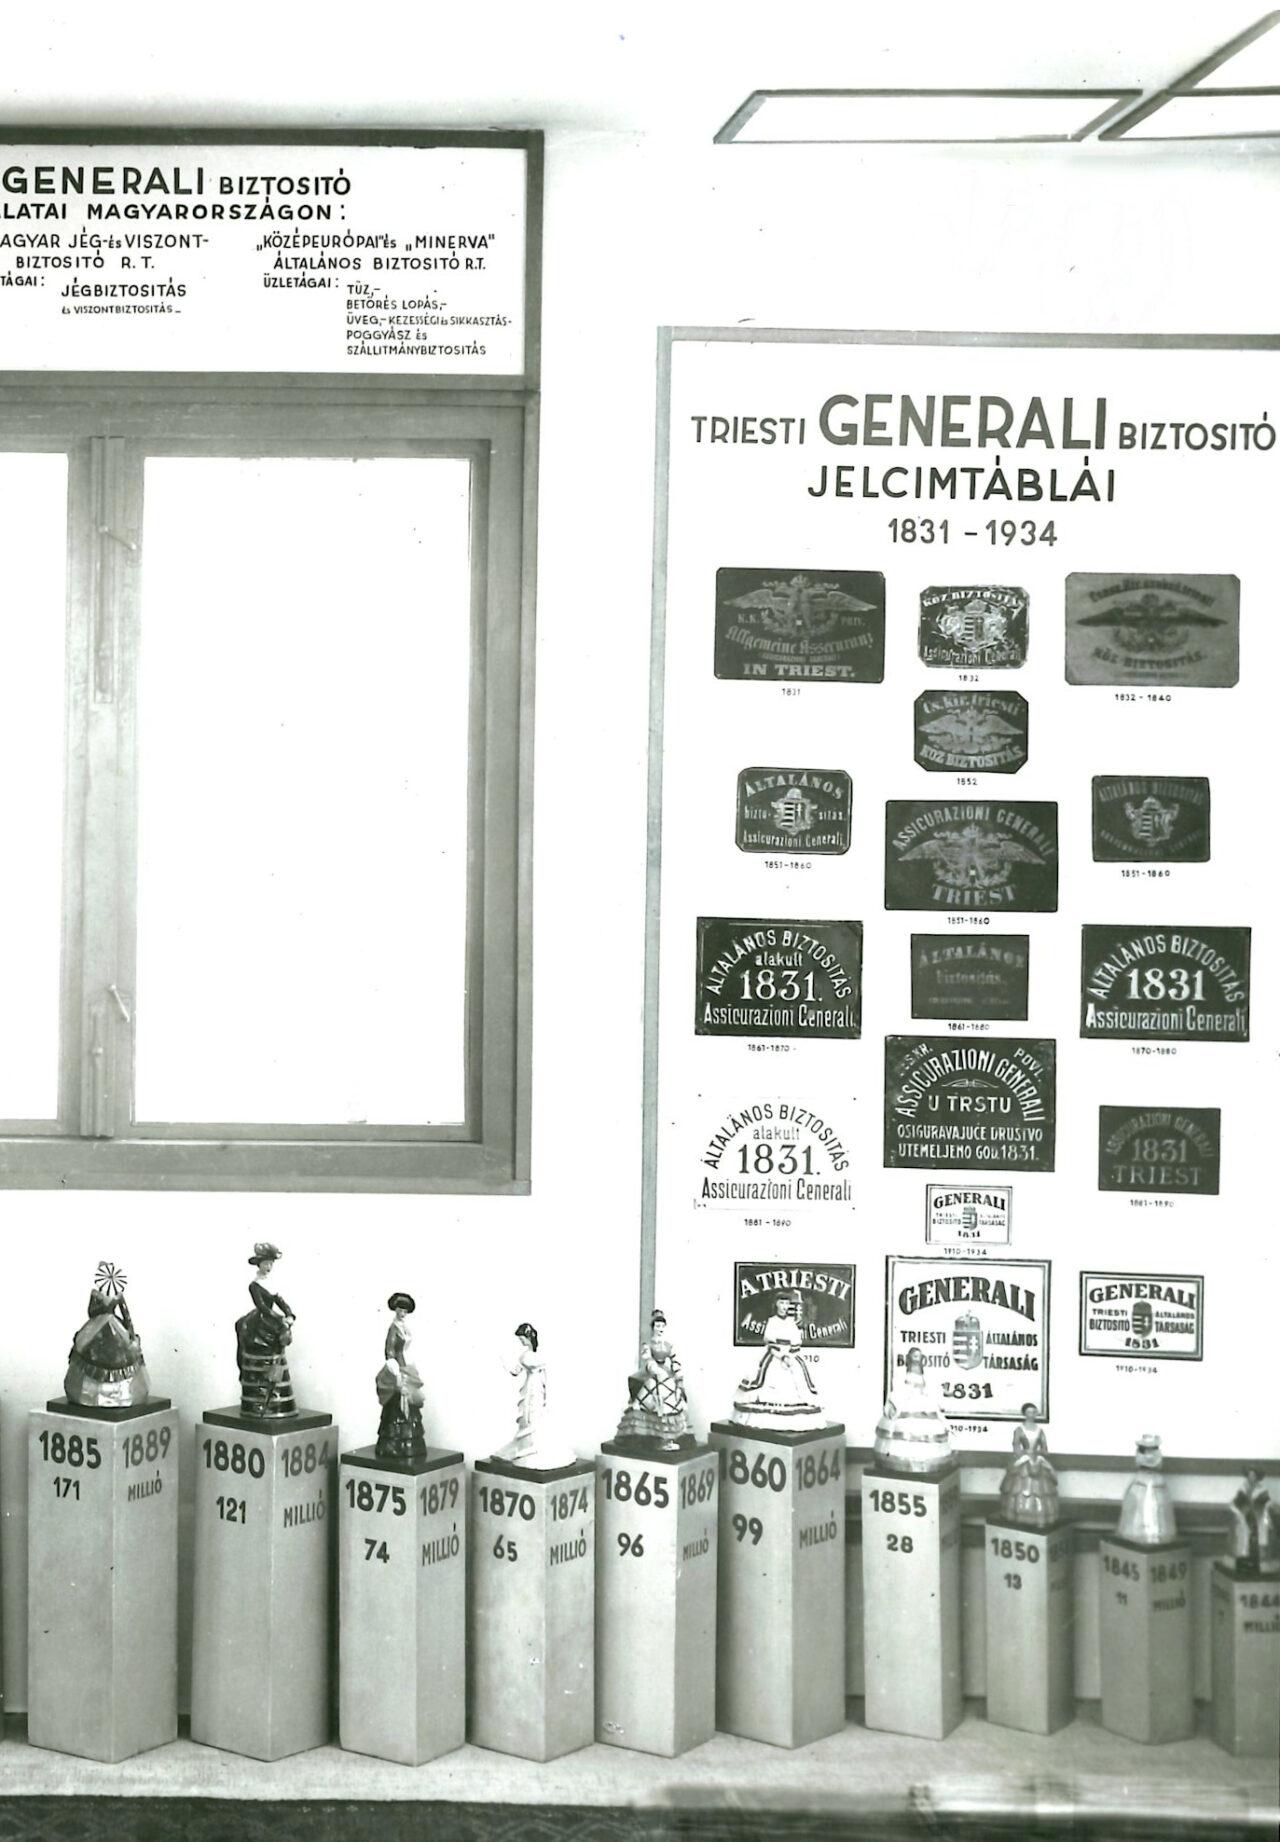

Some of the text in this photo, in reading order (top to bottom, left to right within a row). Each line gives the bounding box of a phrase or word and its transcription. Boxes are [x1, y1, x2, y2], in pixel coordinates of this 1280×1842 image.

[2, 166, 203, 194] GENERALI
[219, 168, 351, 195] BIZTOSITÓ
[16, 249, 104, 268] BIZTOSITÓ
[273, 251, 486, 269] ÁLTALÁNOS BIZTOSITÓ R.T.
[62, 277, 186, 297] JÉGBIZTOSITÁS
[347, 326, 411, 340] POGGYÁSZ
[691, 394, 1276, 450] TRIESTI GENERALI BIZTOSITÓ
[808, 456, 1115, 501] JELCIMTÁBLÁI
[888, 517, 950, 544] 1831
[743, 663, 767, 676] IN
[892, 805, 990, 850] ASSICURAZIONI
[996, 809, 1055, 856] GENERALI
[932, 884, 1017, 906] TRIEST
[755, 951, 803, 966] alakult
[1128, 968, 1206, 1000] 1831
[704, 1002, 794, 1026] Assicurazioni
[1086, 1003, 1183, 1030] Assicurazioni
[895, 1049, 1045, 1121] ASSICURAZIONI GENERALI
[928, 1095, 1011, 1113] U TRSTU
[898, 1143, 971, 1159] UTEMELJENO
[1132, 1138, 1187, 1163] 1831
[702, 1177, 852, 1201] Assicurazioni Generali
[1113, 1165, 1202, 1186] TRIEST
[933, 1192, 1006, 1211] GENERALI
[740, 1269, 851, 1301] A TRIESTI
[1089, 1283, 1196, 1310] GENERALI
[898, 1276, 1035, 1322] GENERALI
[900, 1331, 946, 1344] TRIESTI
[983, 1354, 1039, 1371] TÁRSASÁG
[39, 1426, 171, 1469] 1885 1889
[203, 1438, 329, 1479] 1880 1884
[795, 1448, 841, 1491] 1864
[53, 1470, 162, 1501] 171 MILLIÓ
[345, 1478, 459, 1516] 1875 1879
[601, 1467, 715, 1510] 1865 1869
[216, 1489, 326, 1528] 121 MILLIÓ
[479, 1486, 588, 1521] 1870 1874
[870, 1489, 927, 1517] 1855
[732, 1510, 837, 1549] 99 MILLIÓ
[364, 1522, 459, 1567] 74 MILLIÓ
[493, 1528, 586, 1566] 65 MILLIÓ
[617, 1528, 708, 1561] 96 MILLIÓ
[886, 1534, 914, 1553] 28
[991, 1538, 1040, 1563] 1850
[1003, 1573, 1022, 1590] 13
[1103, 1555, 1140, 1582] 1845
